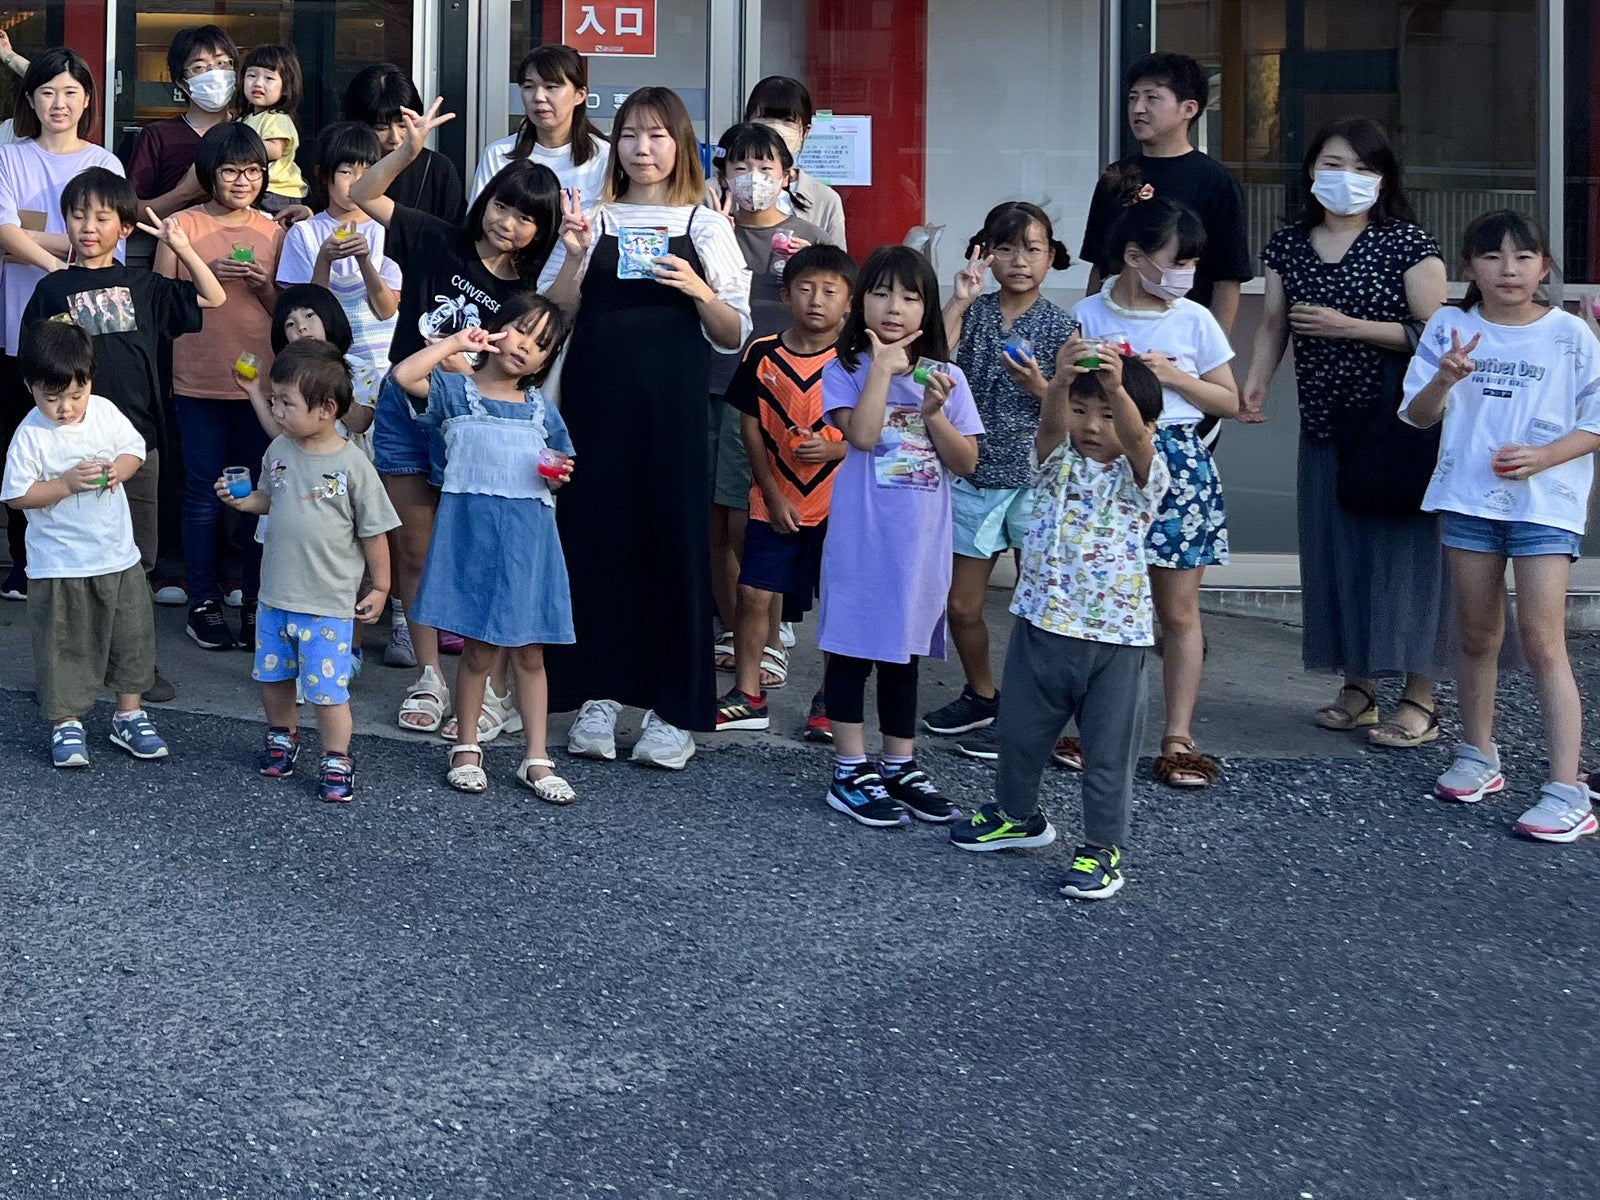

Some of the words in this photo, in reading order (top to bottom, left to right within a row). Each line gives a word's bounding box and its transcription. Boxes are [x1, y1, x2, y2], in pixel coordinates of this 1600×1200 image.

[575, 5, 643, 36] 入口
[451, 274, 502, 314] CONVERSE
[1469, 357, 1517, 376] nother
[1517, 359, 1546, 381] Day
